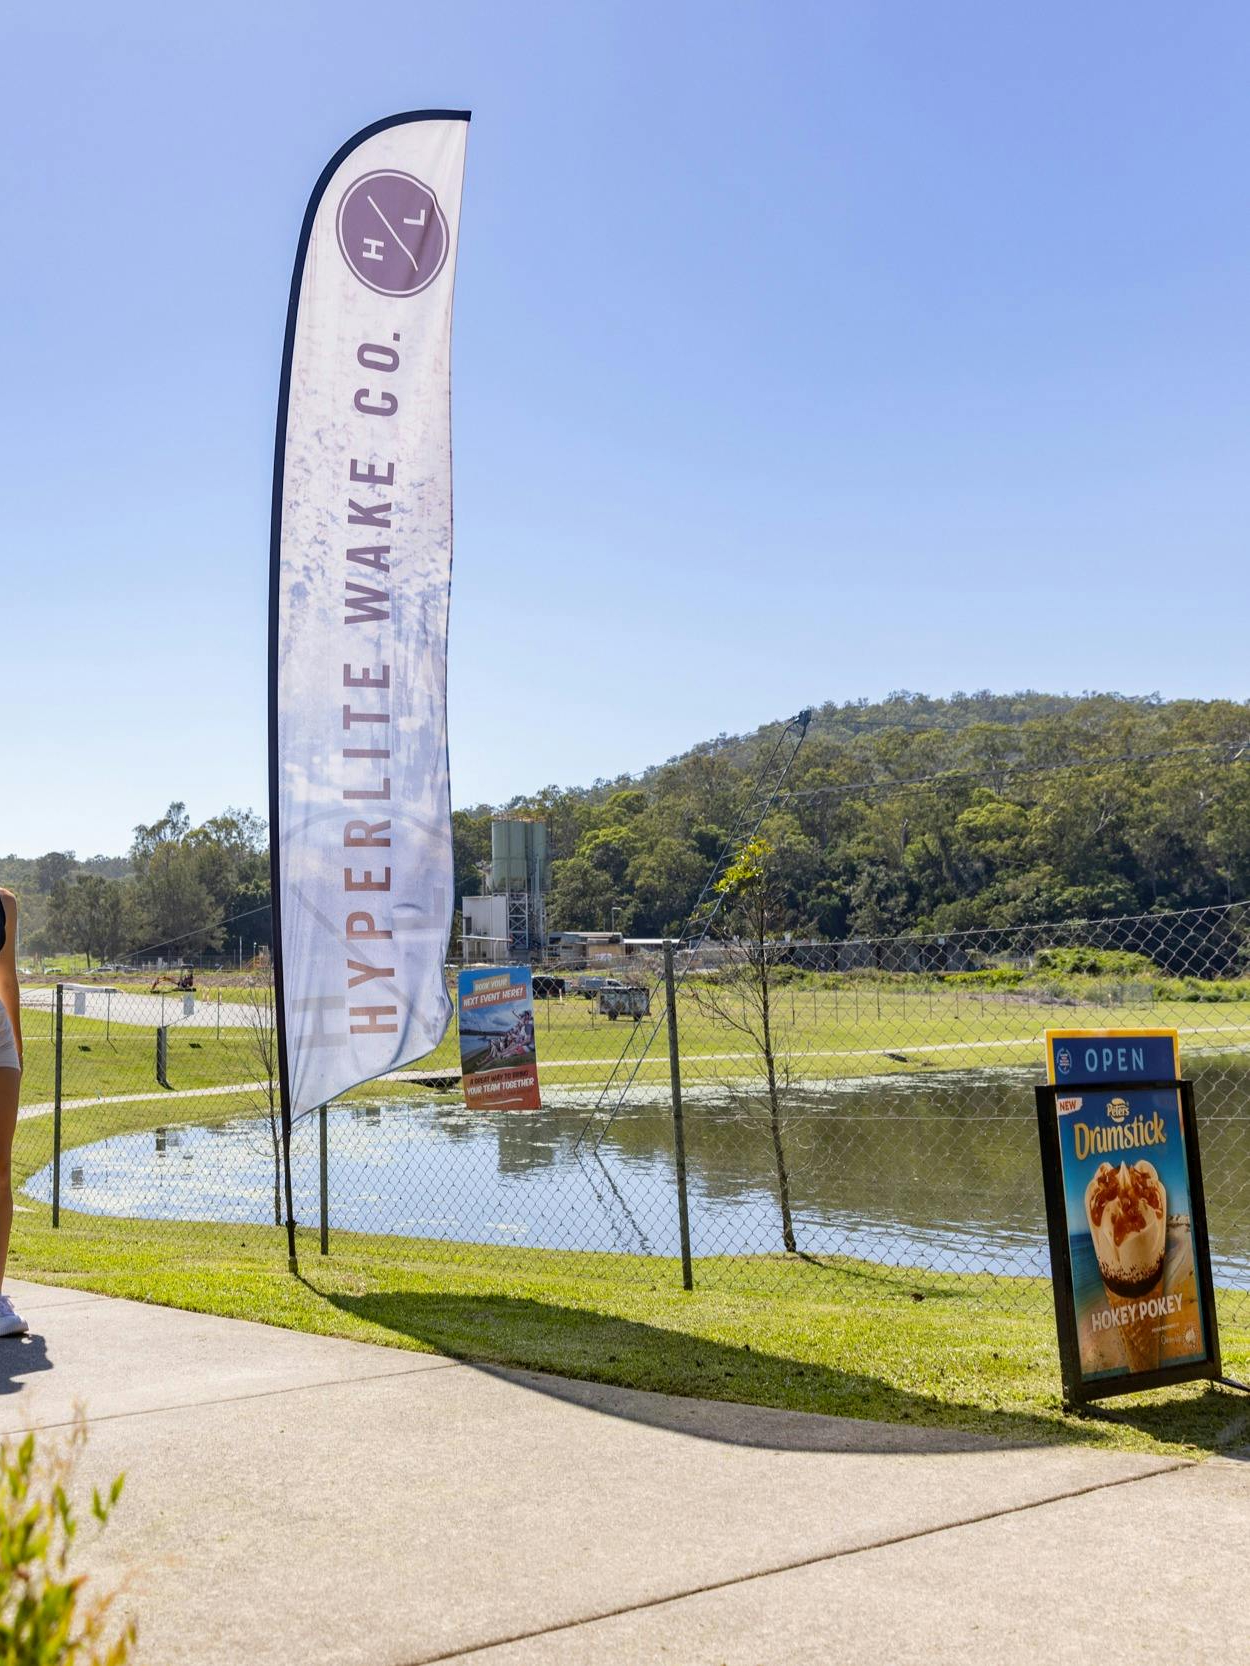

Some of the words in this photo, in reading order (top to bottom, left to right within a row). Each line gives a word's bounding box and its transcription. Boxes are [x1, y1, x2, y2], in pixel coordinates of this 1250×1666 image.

[353, 332, 401, 417] CO.
[344, 458, 395, 625] WAKE
[343, 663, 398, 1035] HYPERLITE
[463, 995, 479, 1007] NEXT
[480, 991, 501, 1004] EVENT
[502, 987, 524, 1000] HERE!
[1085, 1047, 1144, 1073] OPEN
[467, 1085, 483, 1096] YOUR
[483, 1082, 501, 1093] TEAM
[502, 1077, 535, 1090] TOGETHER
[492, 1074, 504, 1082] WAY
[1059, 1100, 1077, 1112] NEW
[1074, 1111, 1167, 1160] Drumstick
[1091, 1303, 1137, 1333] HOKEY
[1139, 1293, 1183, 1321] POKEY
